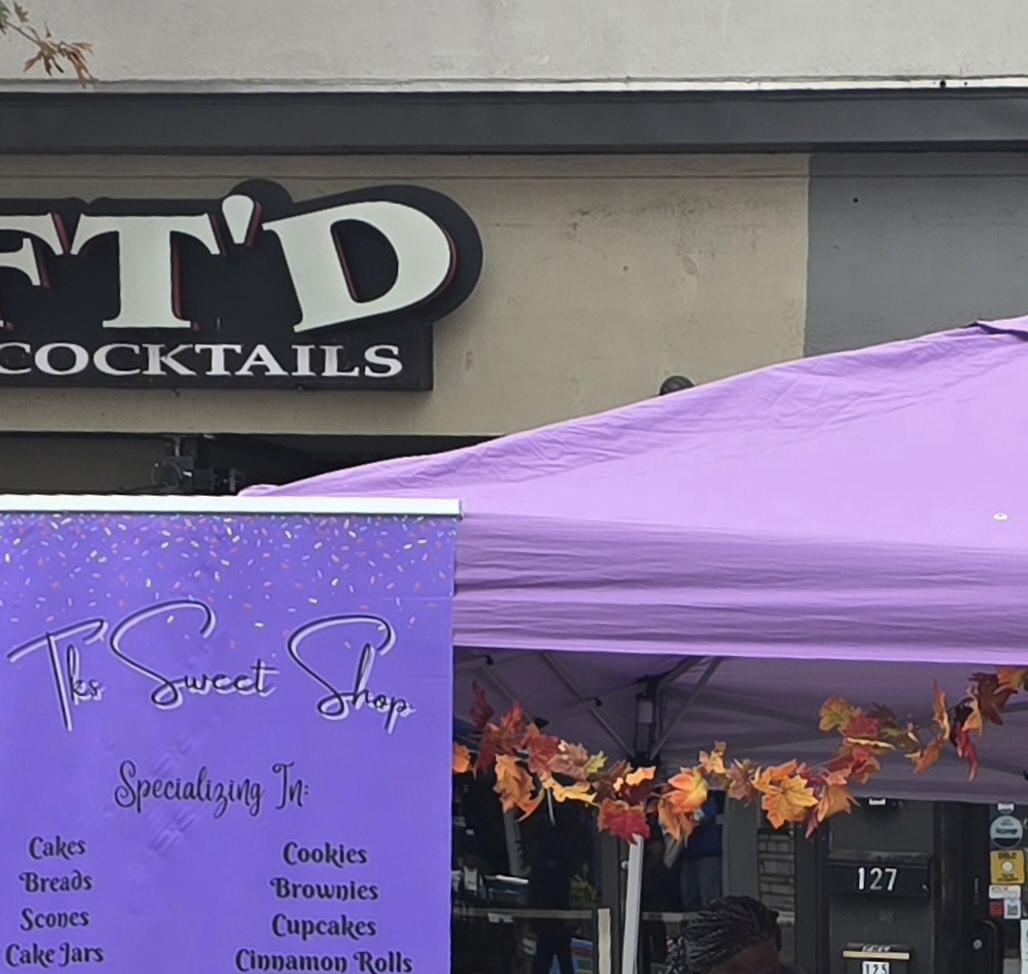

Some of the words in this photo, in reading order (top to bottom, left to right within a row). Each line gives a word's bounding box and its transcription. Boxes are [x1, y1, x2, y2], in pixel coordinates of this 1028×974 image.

[0, 344, 403, 378] COCKTAILS
[109, 599, 279, 709] Sweet
[287, 614, 415, 733] Shop
[114, 760, 264, 818] Specializing
[272, 762, 310, 809] In:
[28, 836, 86, 859] Cakes
[283, 842, 368, 866] Cookies
[19, 872, 93, 893] Breads
[270, 878, 379, 902] Brownies
[857, 867, 898, 891] 127
[20, 908, 90, 931] Scones
[271, 913, 378, 941] Cupcakes
[5, 943, 58, 968] Cake
[59, 943, 104, 966] Jars
[235, 949, 348, 974] Cinnamon
